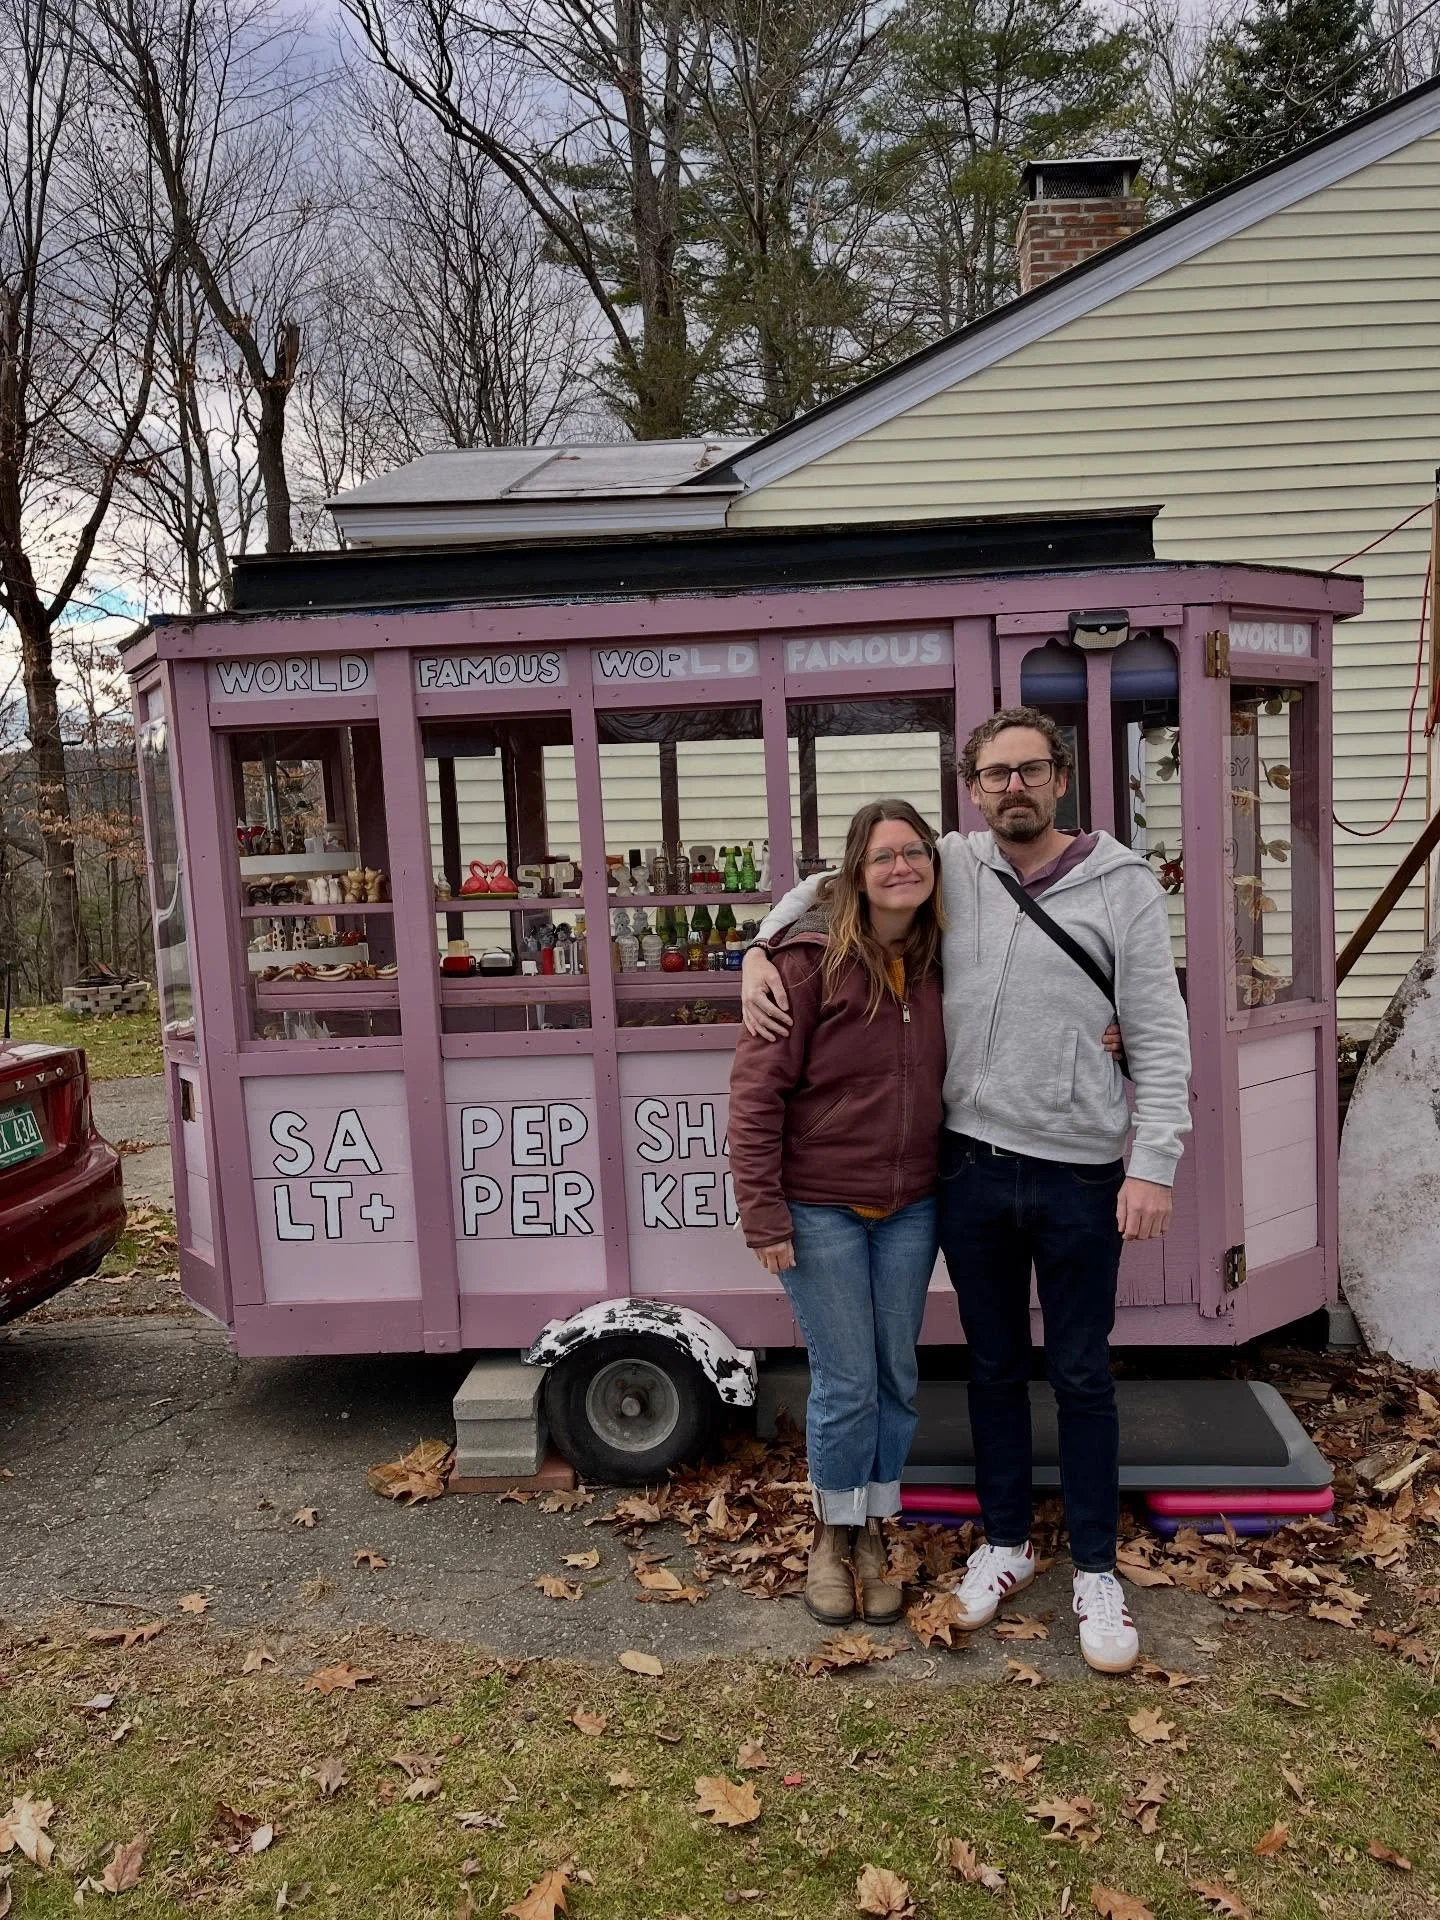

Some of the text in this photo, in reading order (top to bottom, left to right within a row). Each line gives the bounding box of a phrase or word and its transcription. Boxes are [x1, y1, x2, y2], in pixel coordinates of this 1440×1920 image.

[216, 633, 942, 694] WORLD FAMOUS WORLD FAMOUS
[1230, 623, 1309, 655] WORLD
[13, 1115, 38, 1145] 434
[269, 1108, 383, 1177] SA
[460, 1103, 589, 1171] PEP
[634, 1098, 731, 1163] SH
[460, 1170, 595, 1237] PER
